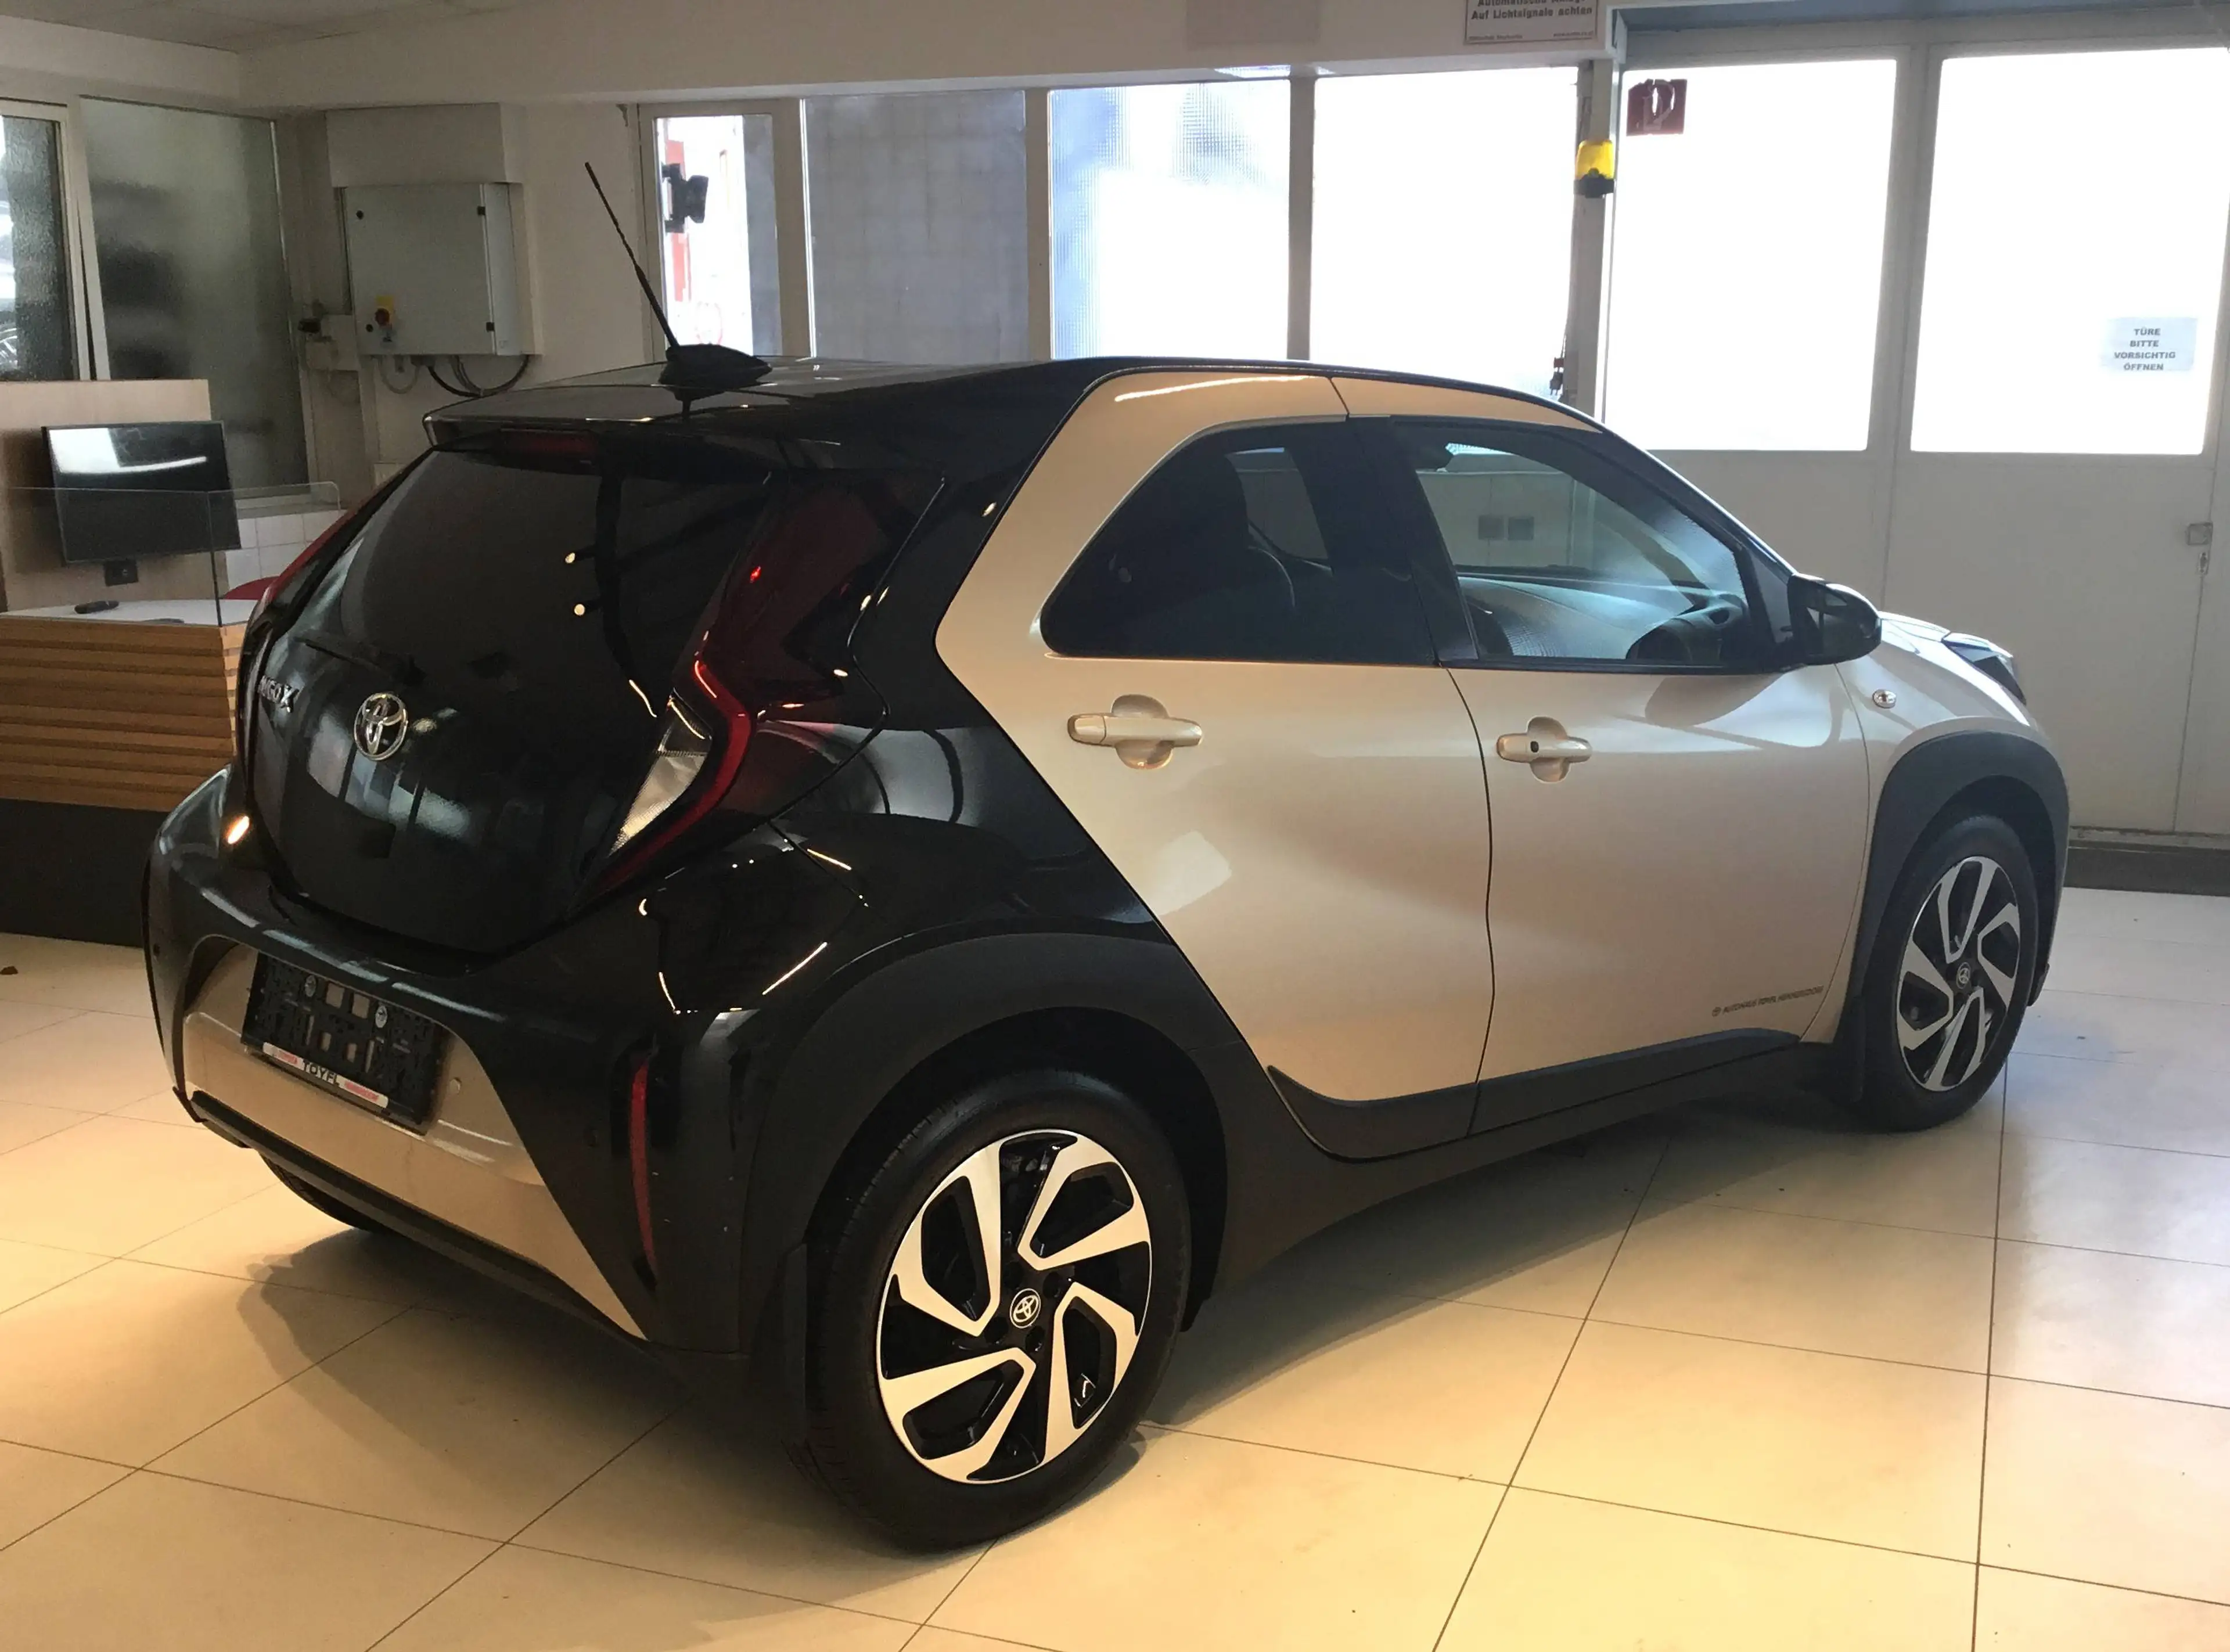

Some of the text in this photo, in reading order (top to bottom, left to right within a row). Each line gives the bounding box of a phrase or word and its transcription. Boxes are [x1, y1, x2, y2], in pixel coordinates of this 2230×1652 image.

[1471, 6, 1592, 20] Auf Lichtsignale achten
[2134, 326, 2161, 336] TÜRE
[2123, 362, 2164, 370] ÖFFNEN
